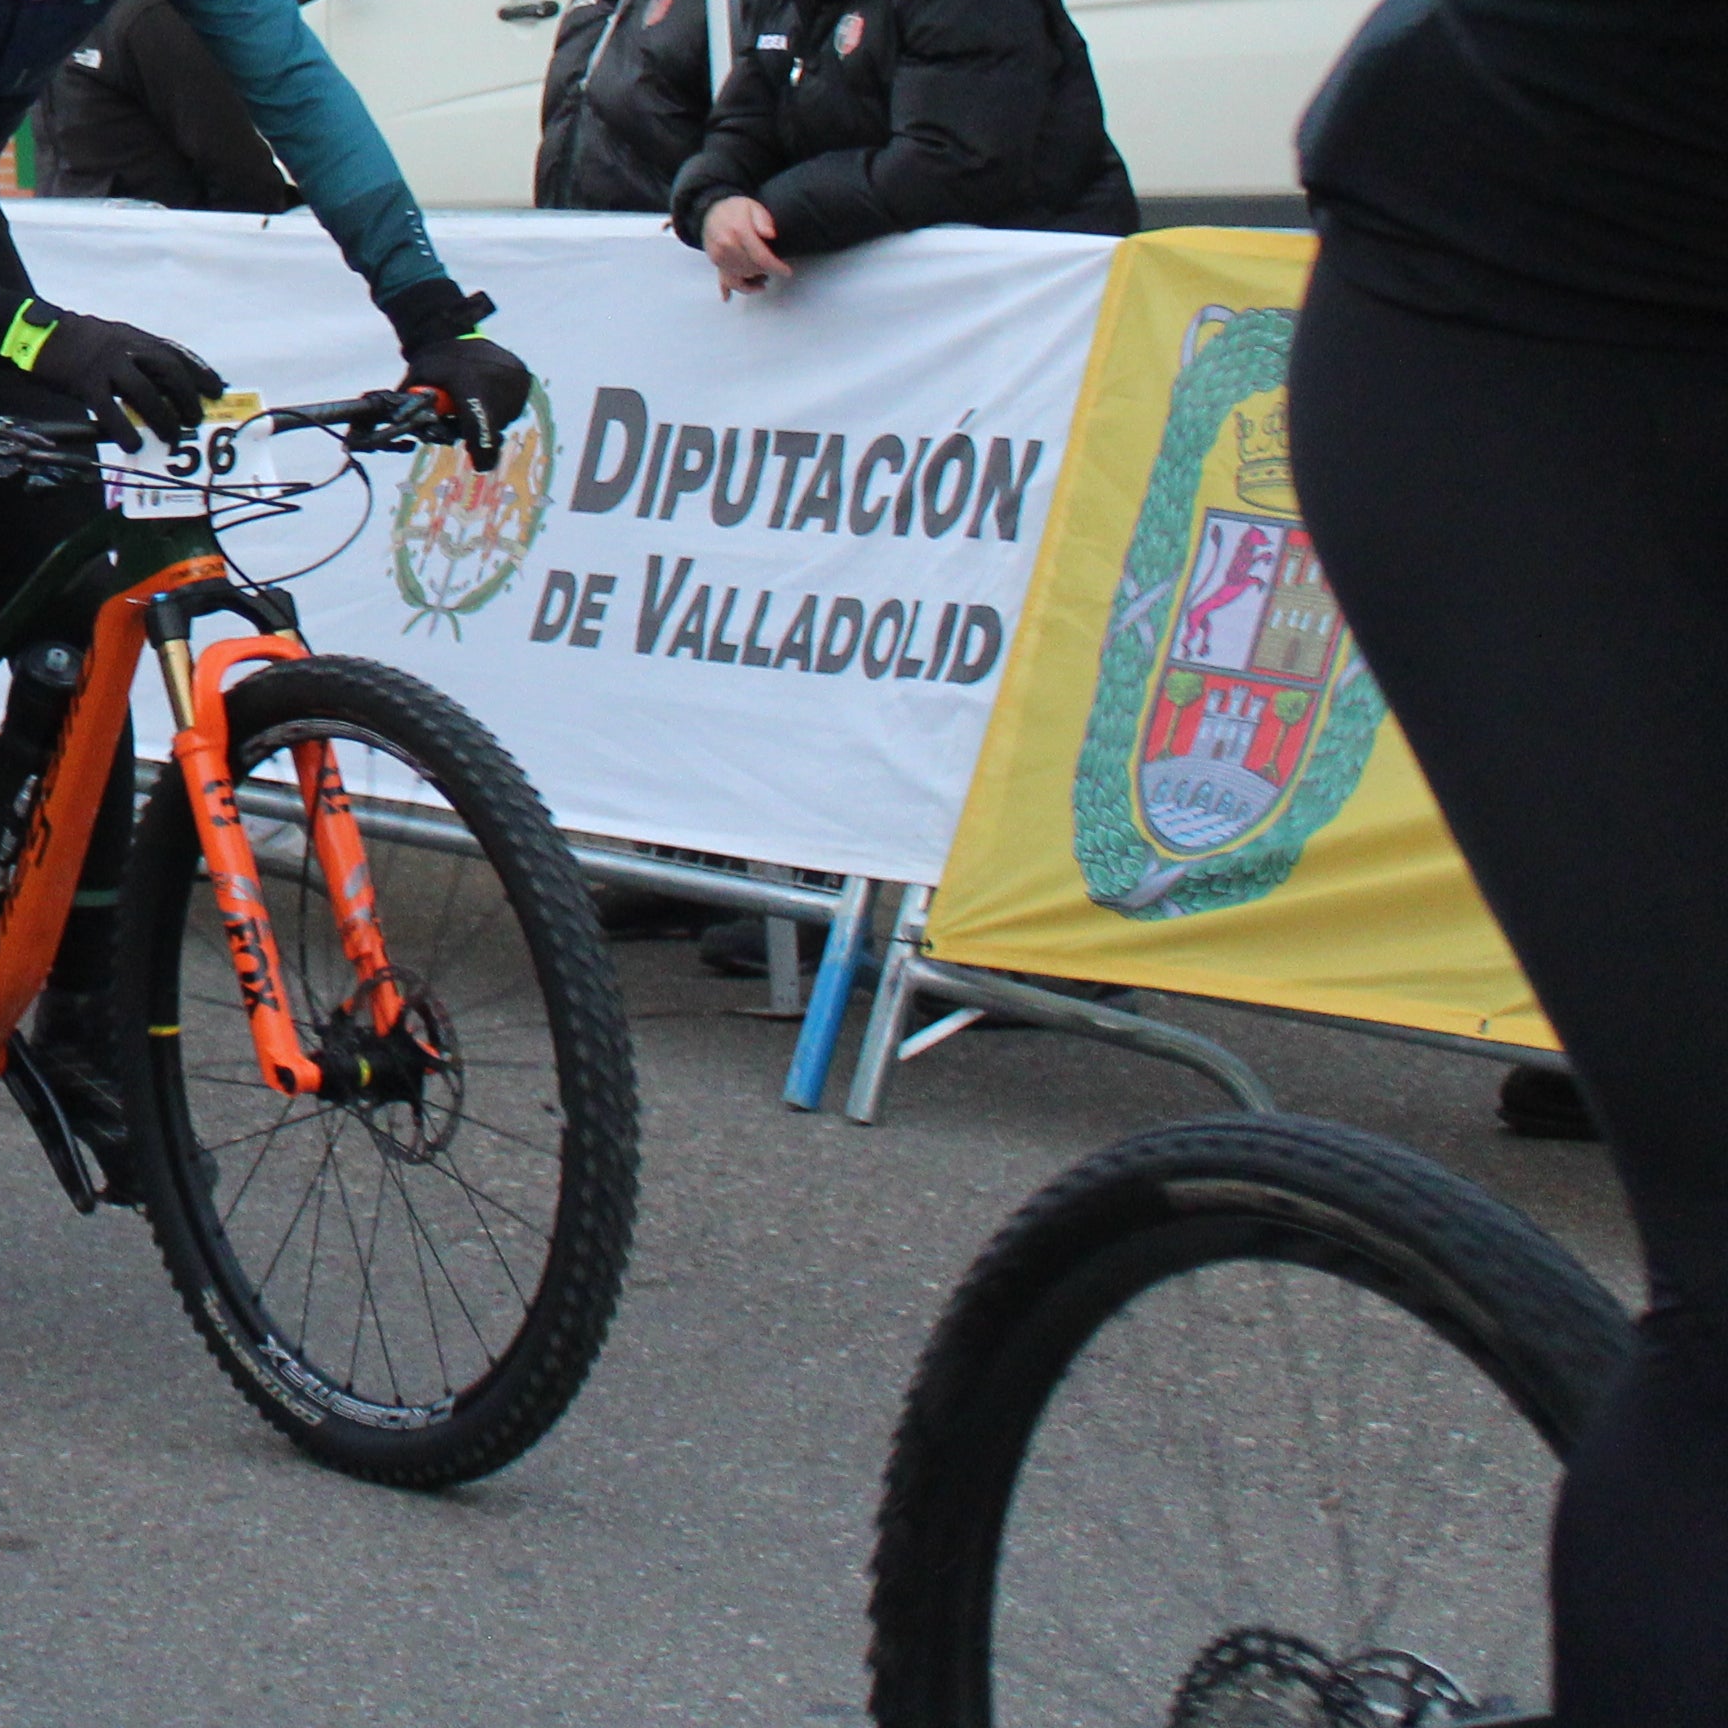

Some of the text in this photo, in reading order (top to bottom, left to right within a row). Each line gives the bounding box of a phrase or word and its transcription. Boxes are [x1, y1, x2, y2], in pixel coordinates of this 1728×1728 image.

[167, 425, 236, 476] 56
[569, 386, 1044, 542] DIPUTACIÓN
[528, 553, 1003, 685] DE VALLADOLID
[226, 917, 280, 1019] FOX
